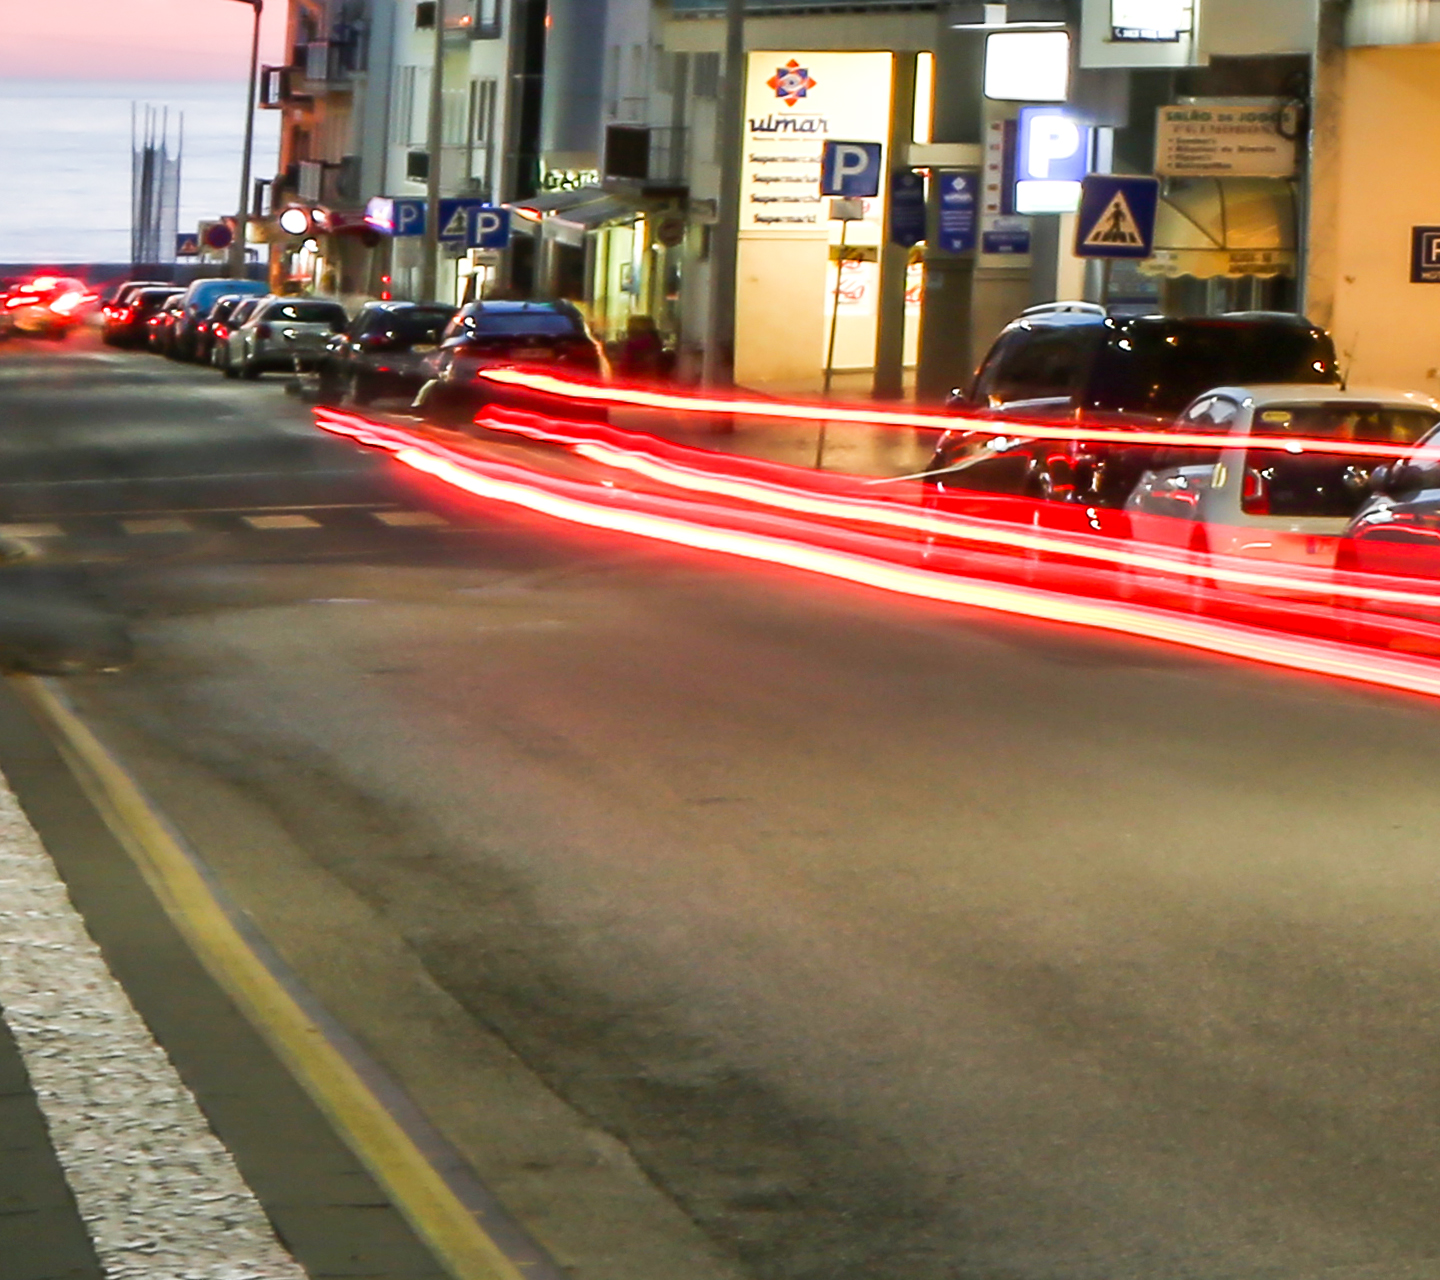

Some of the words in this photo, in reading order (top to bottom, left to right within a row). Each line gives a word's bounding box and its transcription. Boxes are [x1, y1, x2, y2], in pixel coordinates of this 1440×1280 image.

[748, 113, 829, 133] ulmar
[1028, 114, 1080, 179] P
[832, 144, 869, 192] P
[398, 204, 416, 232] P
[476, 212, 500, 244] P
